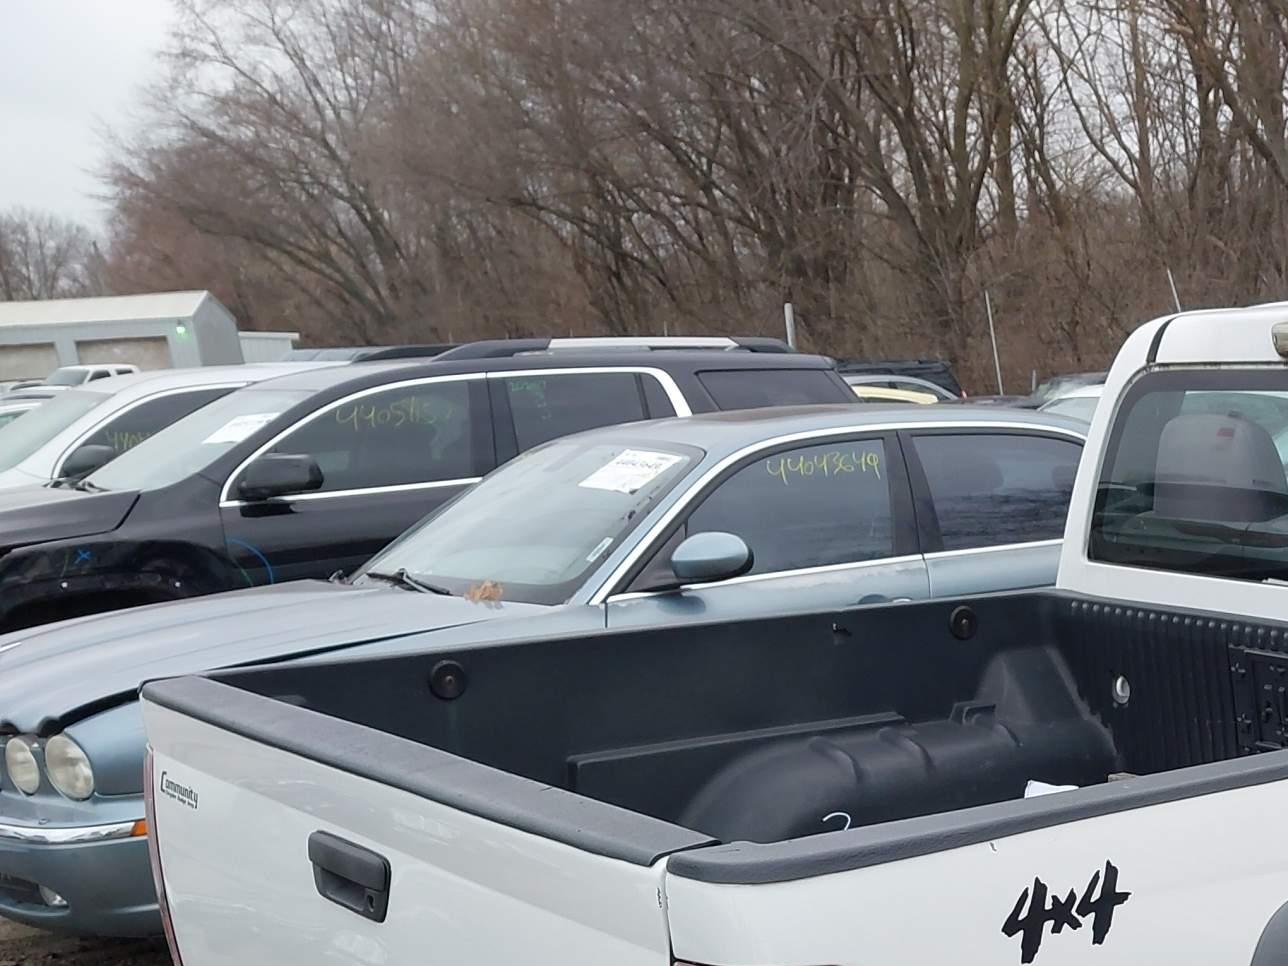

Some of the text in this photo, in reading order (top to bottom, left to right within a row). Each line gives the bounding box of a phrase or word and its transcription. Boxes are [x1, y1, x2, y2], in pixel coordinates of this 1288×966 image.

[766, 450, 880, 485] 44043649
[160, 771, 198, 809] Community
[1001, 859, 1132, 964] 4x4
